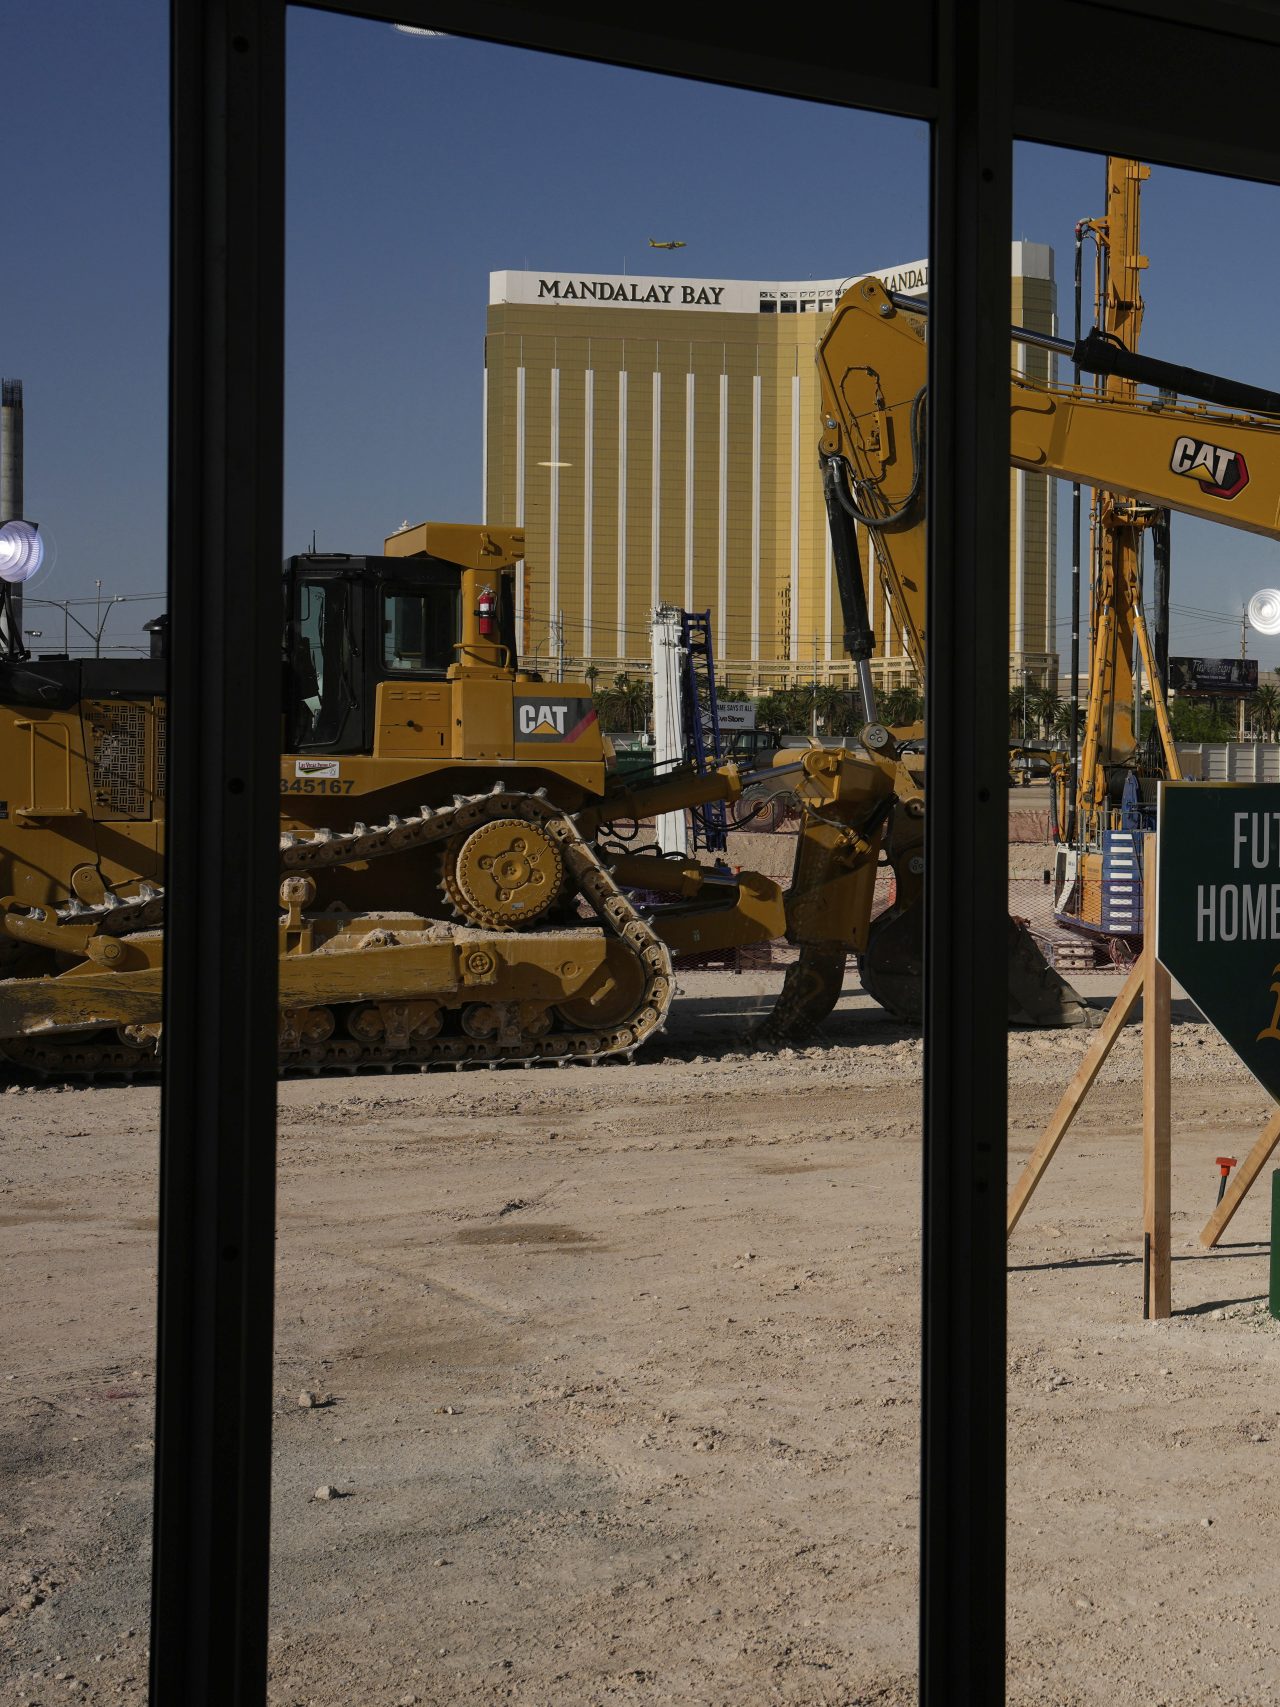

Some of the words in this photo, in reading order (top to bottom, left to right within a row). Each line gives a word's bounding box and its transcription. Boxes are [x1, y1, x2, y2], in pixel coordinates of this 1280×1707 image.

[538, 279, 675, 303] MANDALAY
[681, 285, 725, 305] BAY
[1171, 437, 1236, 486] CAT
[519, 704, 568, 735] CAT
